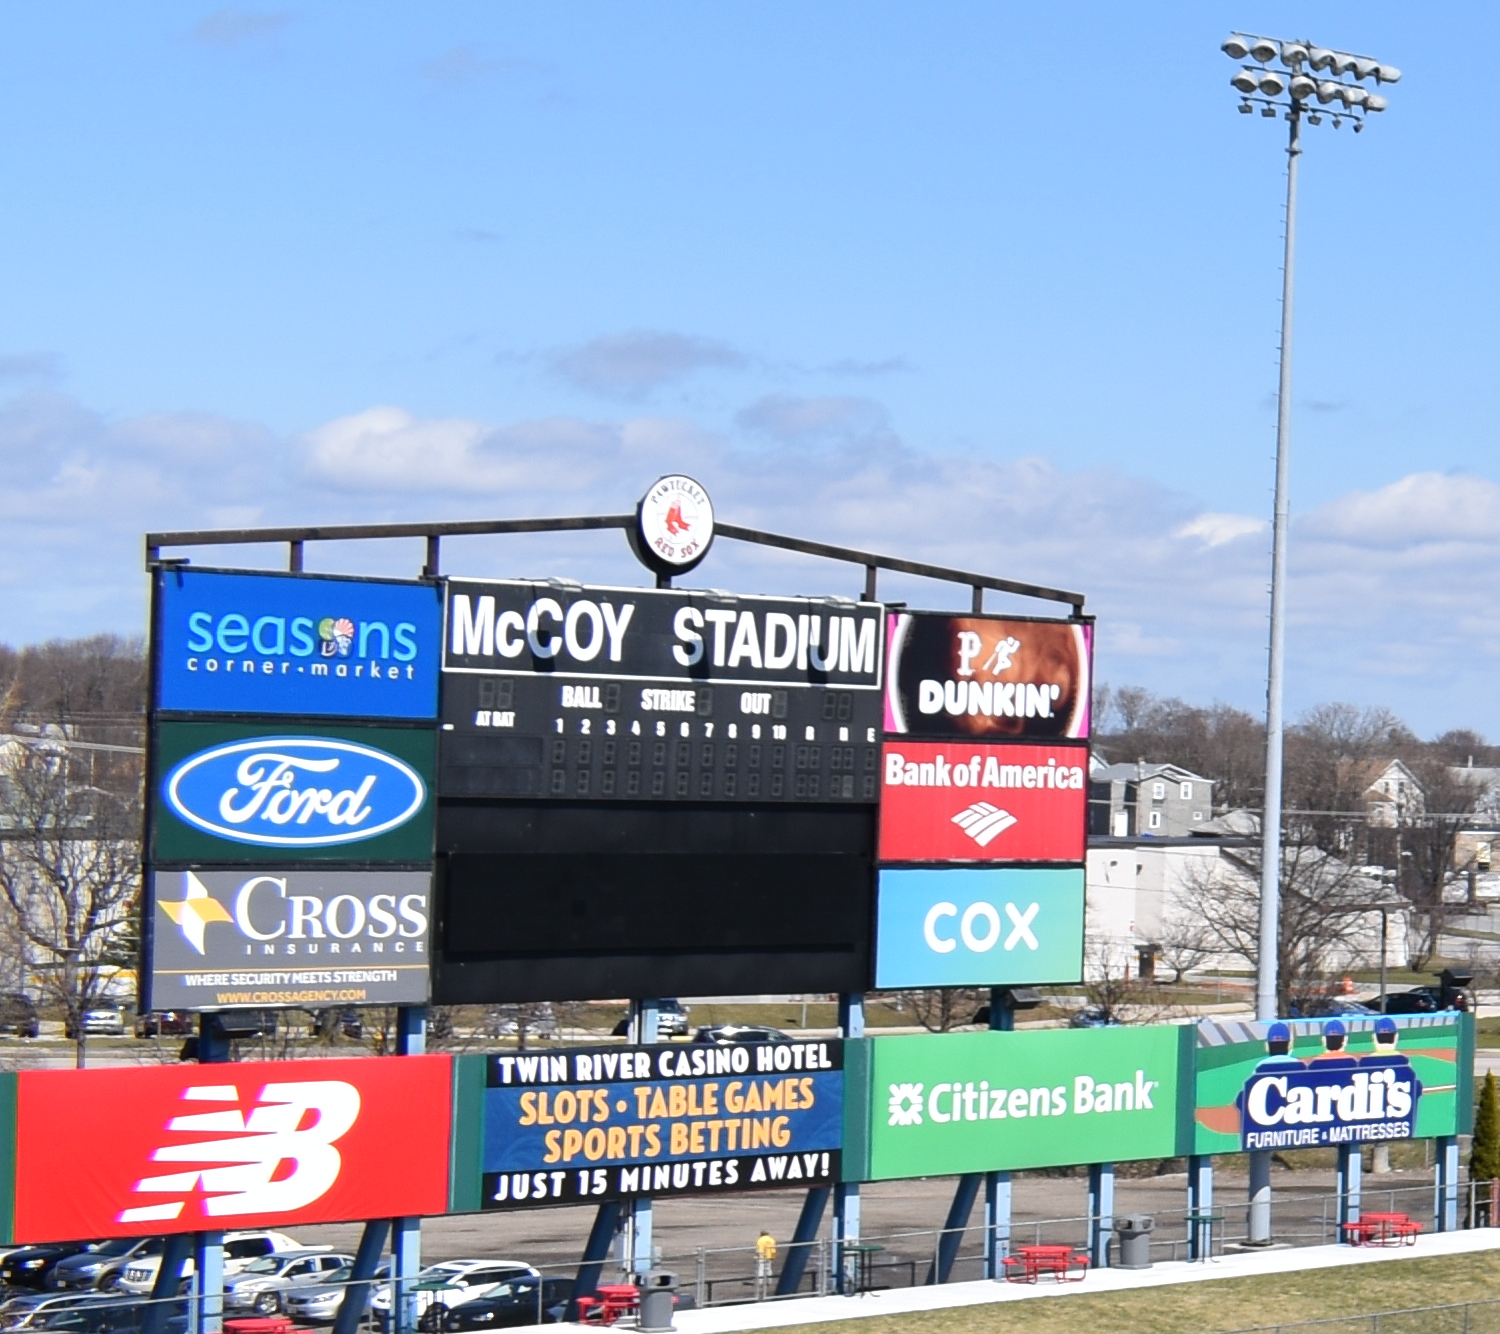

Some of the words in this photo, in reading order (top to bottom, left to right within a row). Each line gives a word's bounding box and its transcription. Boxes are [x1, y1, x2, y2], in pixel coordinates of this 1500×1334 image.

[654, 537, 674, 557] RED
[681, 539, 700, 558] SOX
[452, 594, 635, 662] McCOY
[673, 607, 876, 674] STADIUM
[476, 711, 491, 727] AT
[493, 712, 514, 728] BAT
[562, 685, 602, 709] BALL
[641, 689, 695, 712] STRIKE
[740, 693, 771, 714] OUT
[918, 680, 1060, 718] DUNKIN'
[219, 752, 375, 827] Ford
[885, 753, 951, 786] Bank
[953, 755, 981, 787] of
[985, 757, 1083, 789] America
[924, 901, 1040, 954] COX
[499, 1055, 567, 1084] TWIN
[576, 1052, 651, 1081] RIVER
[658, 1047, 749, 1077] CASINO
[756, 1043, 832, 1072] HOTEL
[519, 1089, 609, 1126] SLOTS
[634, 1082, 718, 1119] TABLE
[724, 1077, 815, 1113] GAMES
[928, 1082, 1067, 1123] Citizens
[1073, 1070, 1155, 1116] Bank
[1246, 1067, 1411, 1125] Cardi's
[543, 1124, 661, 1163] SPORTS
[670, 1116, 791, 1155] BETTING
[494, 1171, 566, 1201] JUST
[579, 1169, 608, 1195] 15
[620, 1159, 739, 1194] MINUTES
[751, 1152, 830, 1183] AWAY!
